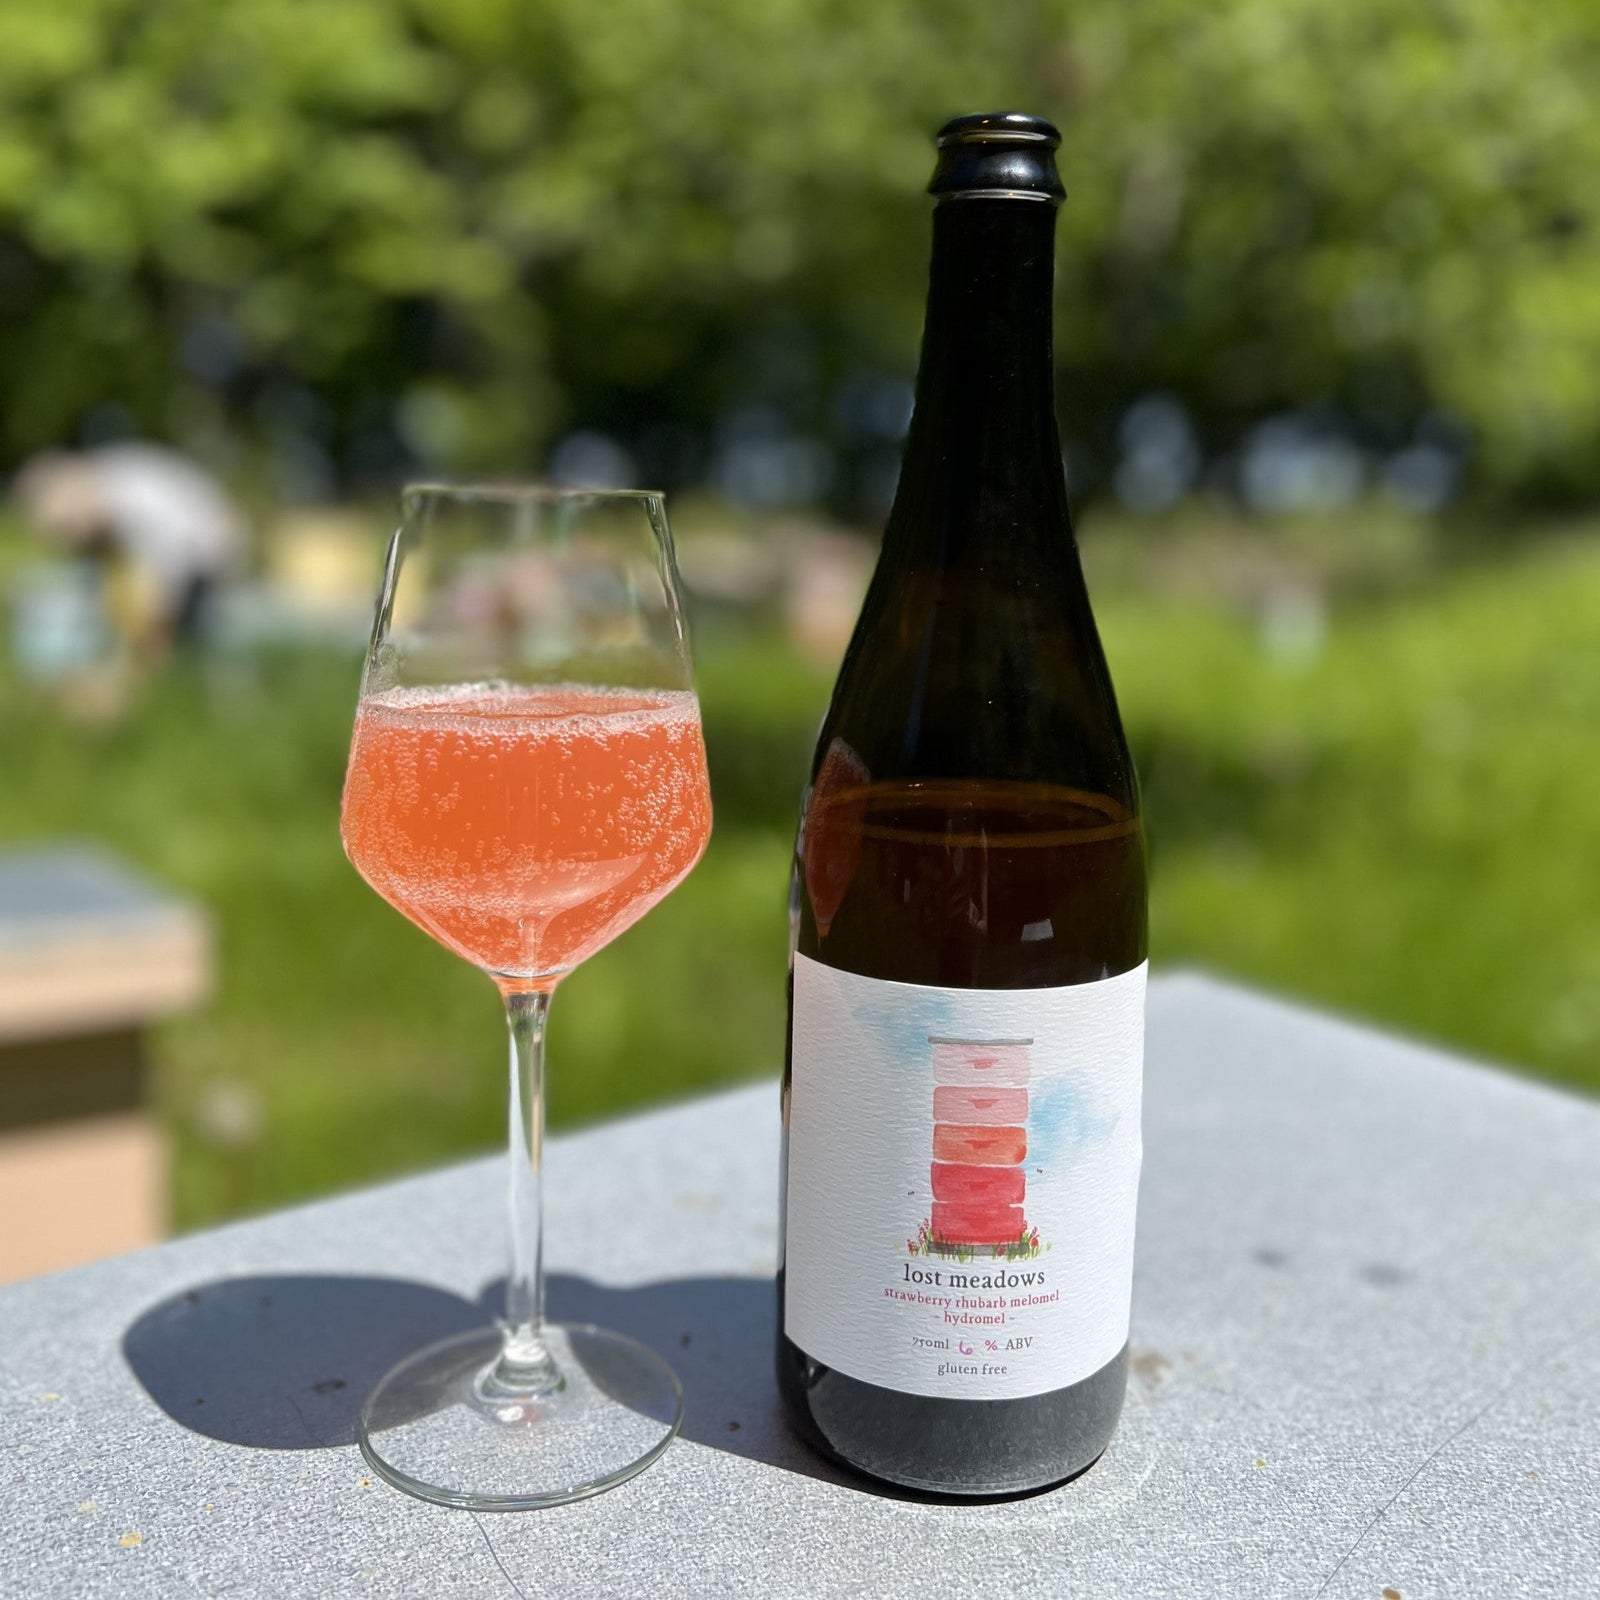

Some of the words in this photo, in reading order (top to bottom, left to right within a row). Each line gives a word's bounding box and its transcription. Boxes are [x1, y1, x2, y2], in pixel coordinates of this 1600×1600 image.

[903, 1263, 942, 1286] lost
[949, 1270, 1045, 1288] meadows
[884, 1287, 952, 1308] strawberry
[955, 1297, 1007, 1308] rhubarb
[1010, 1290, 1060, 1307] melomel
[944, 1311, 1005, 1326] hydromel
[912, 1337, 949, 1350] 750ml
[958, 1340, 974, 1355] 6
[984, 1339, 998, 1351] %
[1004, 1336, 1033, 1350] ABV
[937, 1362, 978, 1376] gluten
[981, 1363, 1008, 1374] free
